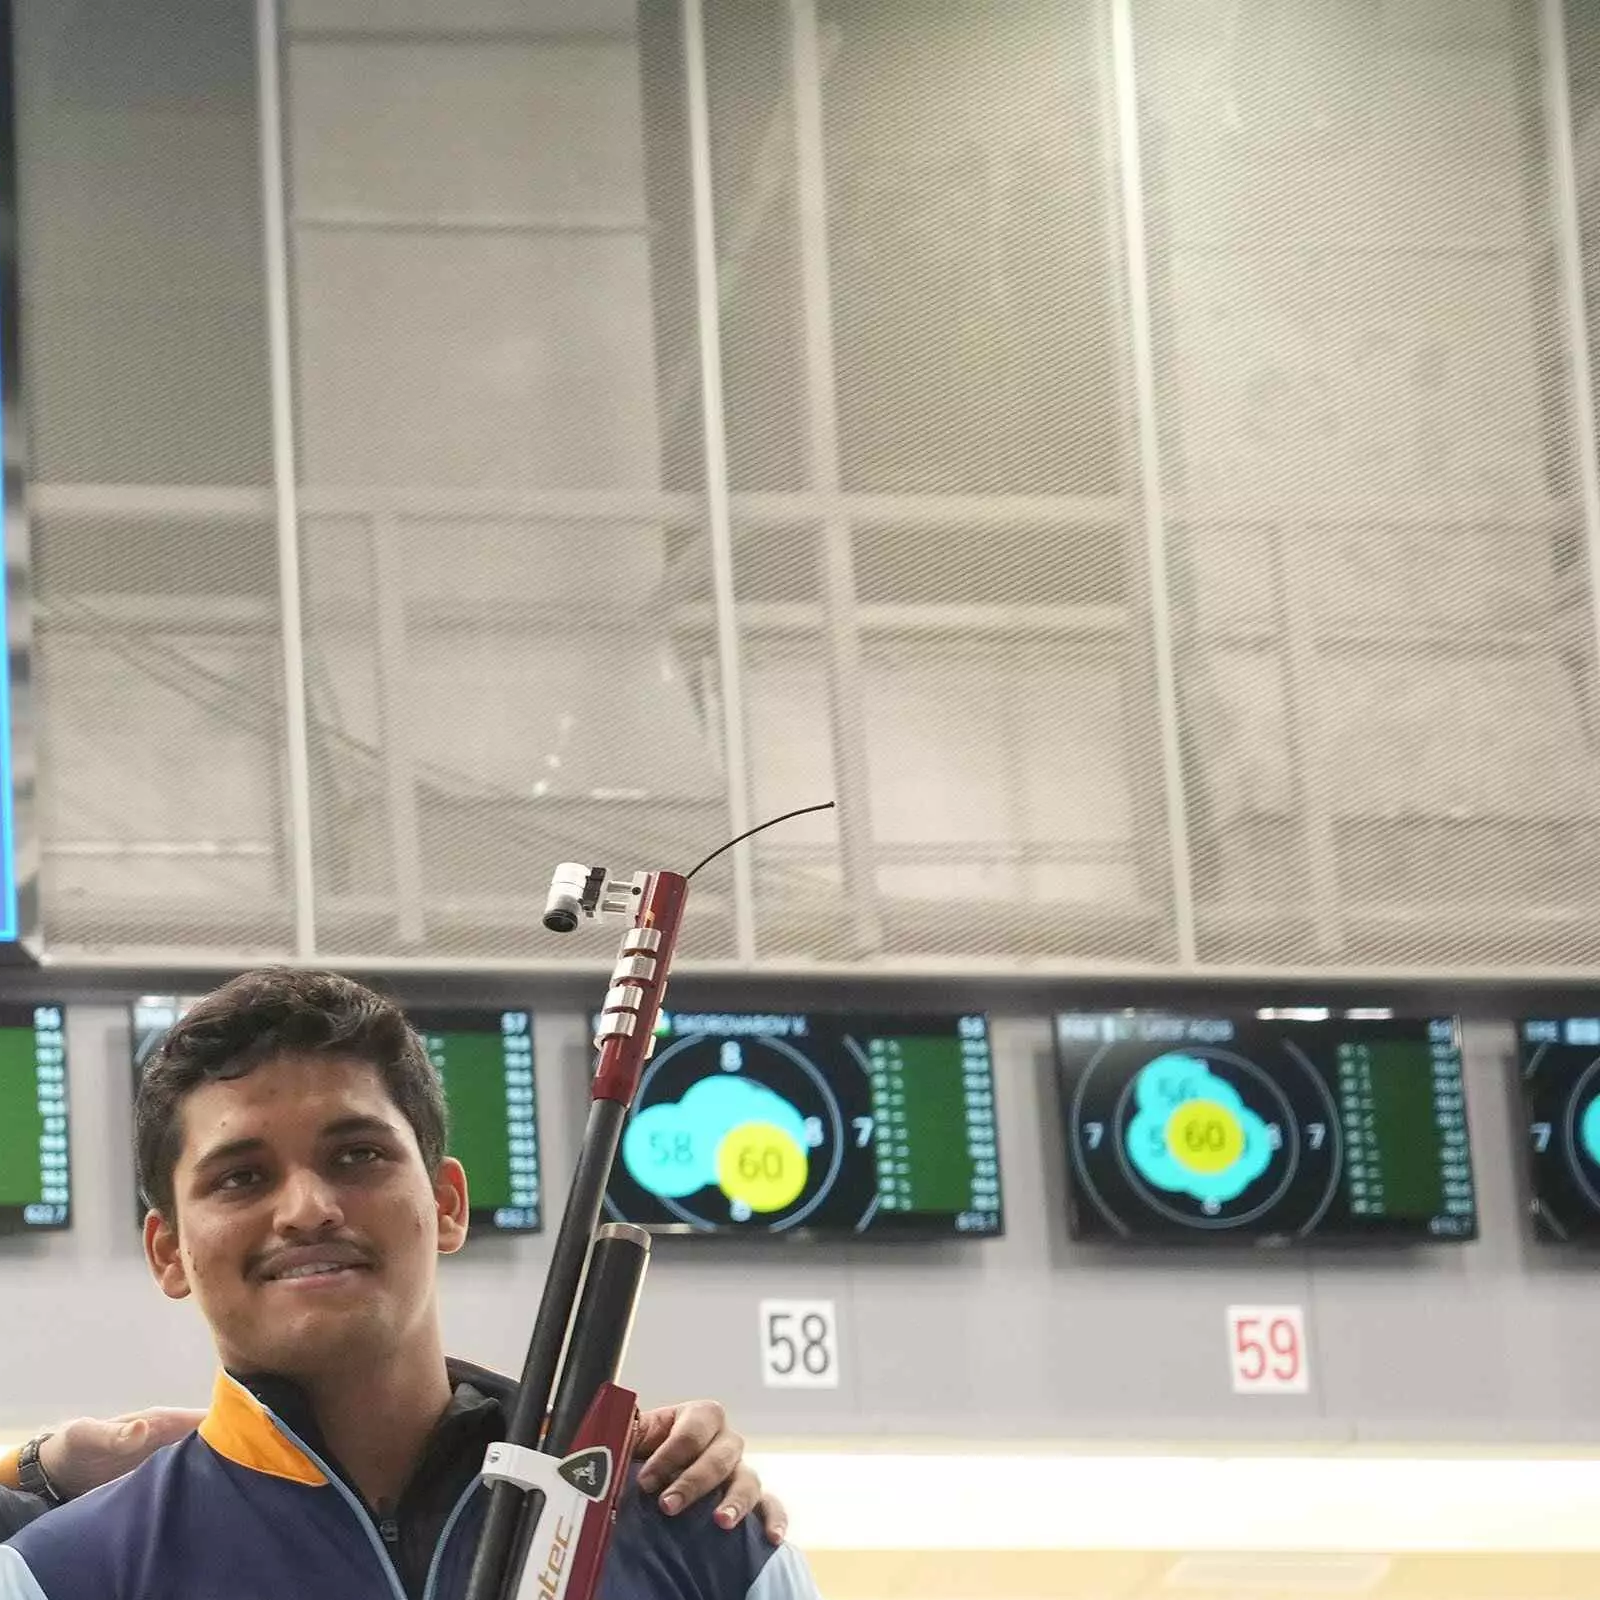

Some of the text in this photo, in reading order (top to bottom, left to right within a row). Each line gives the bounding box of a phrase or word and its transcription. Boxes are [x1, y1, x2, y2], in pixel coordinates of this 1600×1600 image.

[1185, 1120, 1227, 1150] 60
[738, 1147, 784, 1182] 60
[769, 1313, 831, 1375] 58
[1235, 1318, 1301, 1382] 59
